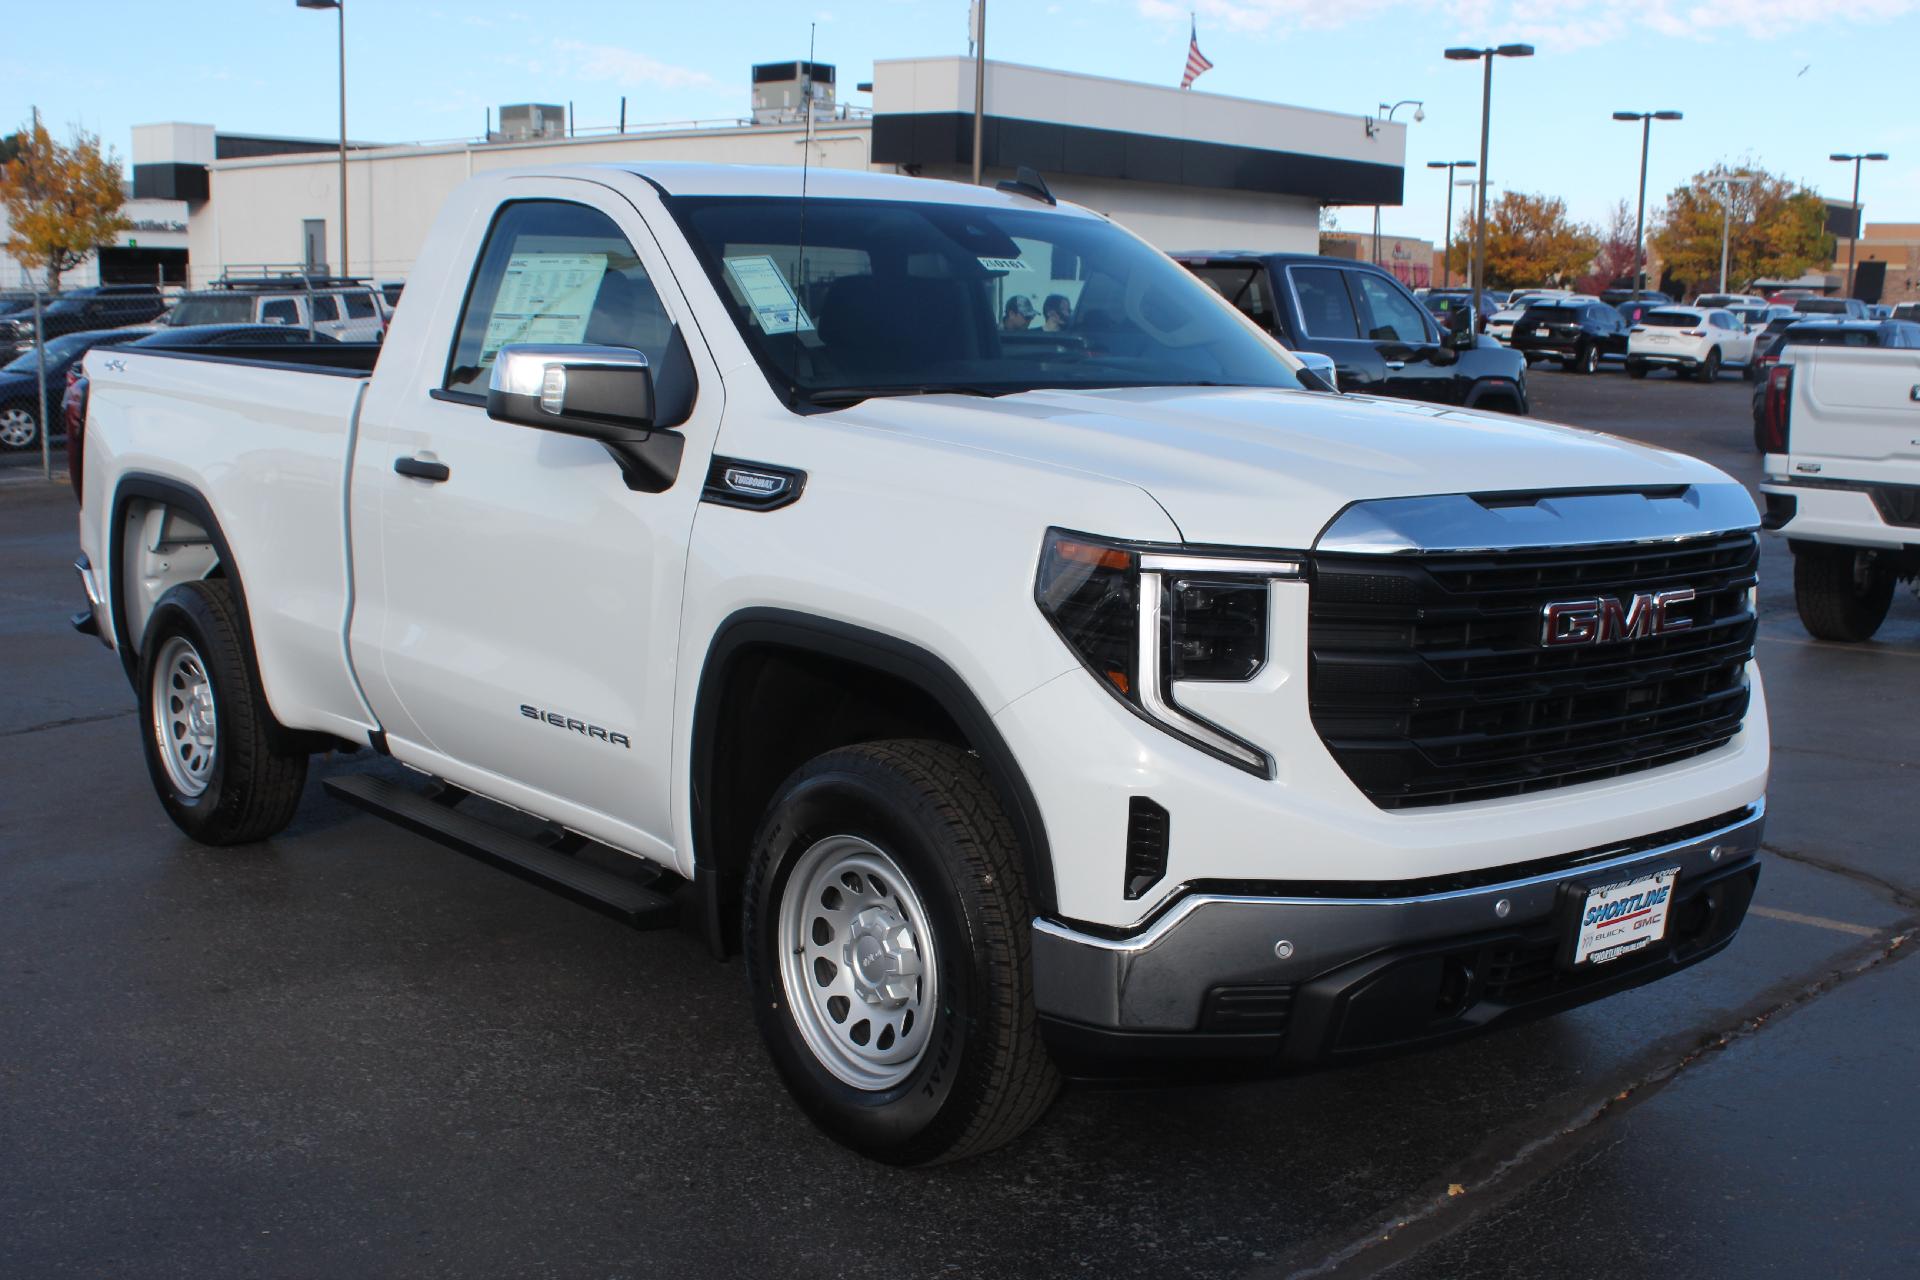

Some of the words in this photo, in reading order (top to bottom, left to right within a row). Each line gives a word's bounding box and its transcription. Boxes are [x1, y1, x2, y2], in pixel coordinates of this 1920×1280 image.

[1540, 588, 1696, 648] GMC
[520, 703, 632, 749] SIERRA
[1584, 885, 1670, 926] SHORTLINE
[1595, 928, 1625, 941] BUICK
[1633, 913, 1661, 930] GMC
